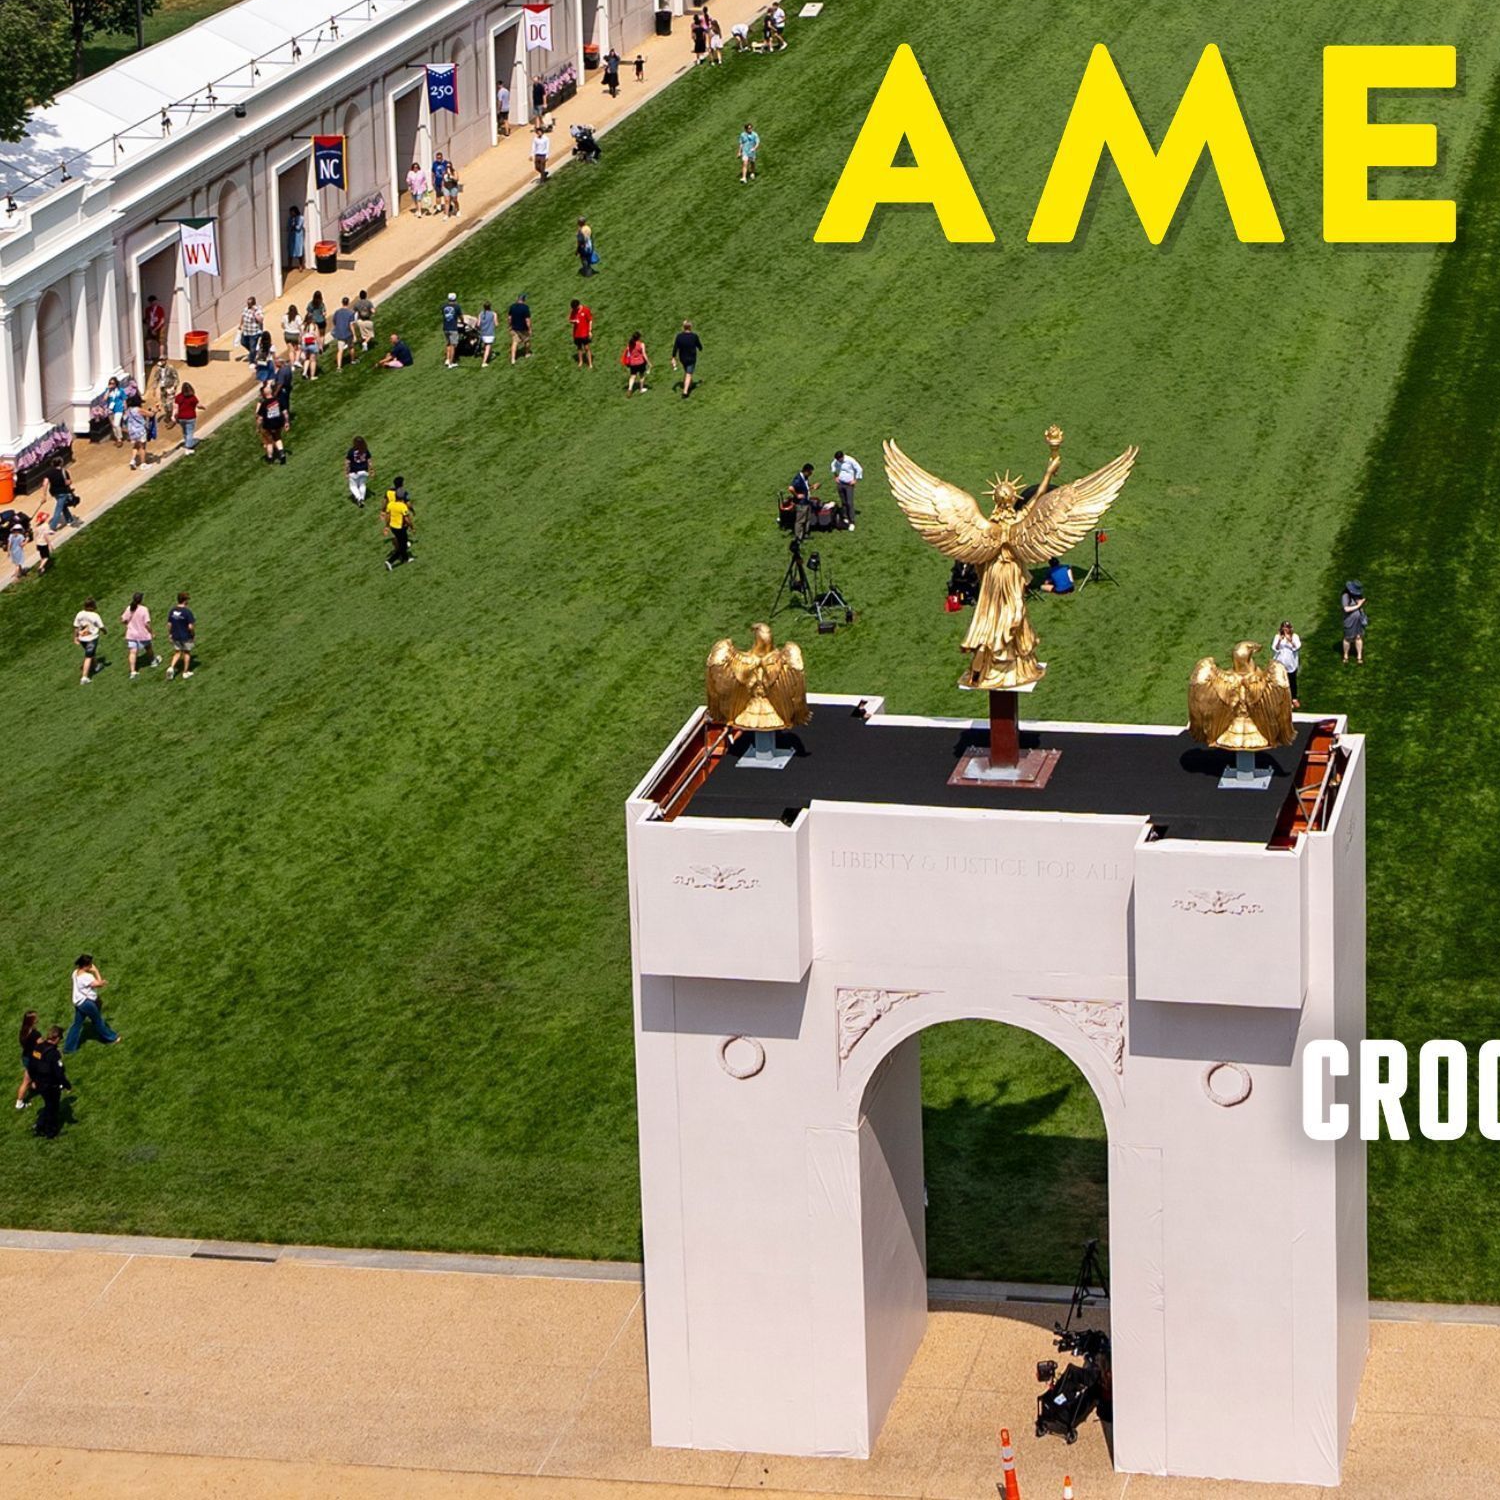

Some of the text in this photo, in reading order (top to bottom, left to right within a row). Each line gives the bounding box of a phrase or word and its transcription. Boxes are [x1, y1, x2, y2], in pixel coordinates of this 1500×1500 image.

[530, 24, 547, 41] DC
[430, 85, 454, 99] 250
[320, 159, 340, 179] NC
[184, 243, 212, 265] WV
[831, 850, 1125, 881] LIBERTY & JUSTICE FOR ALL
